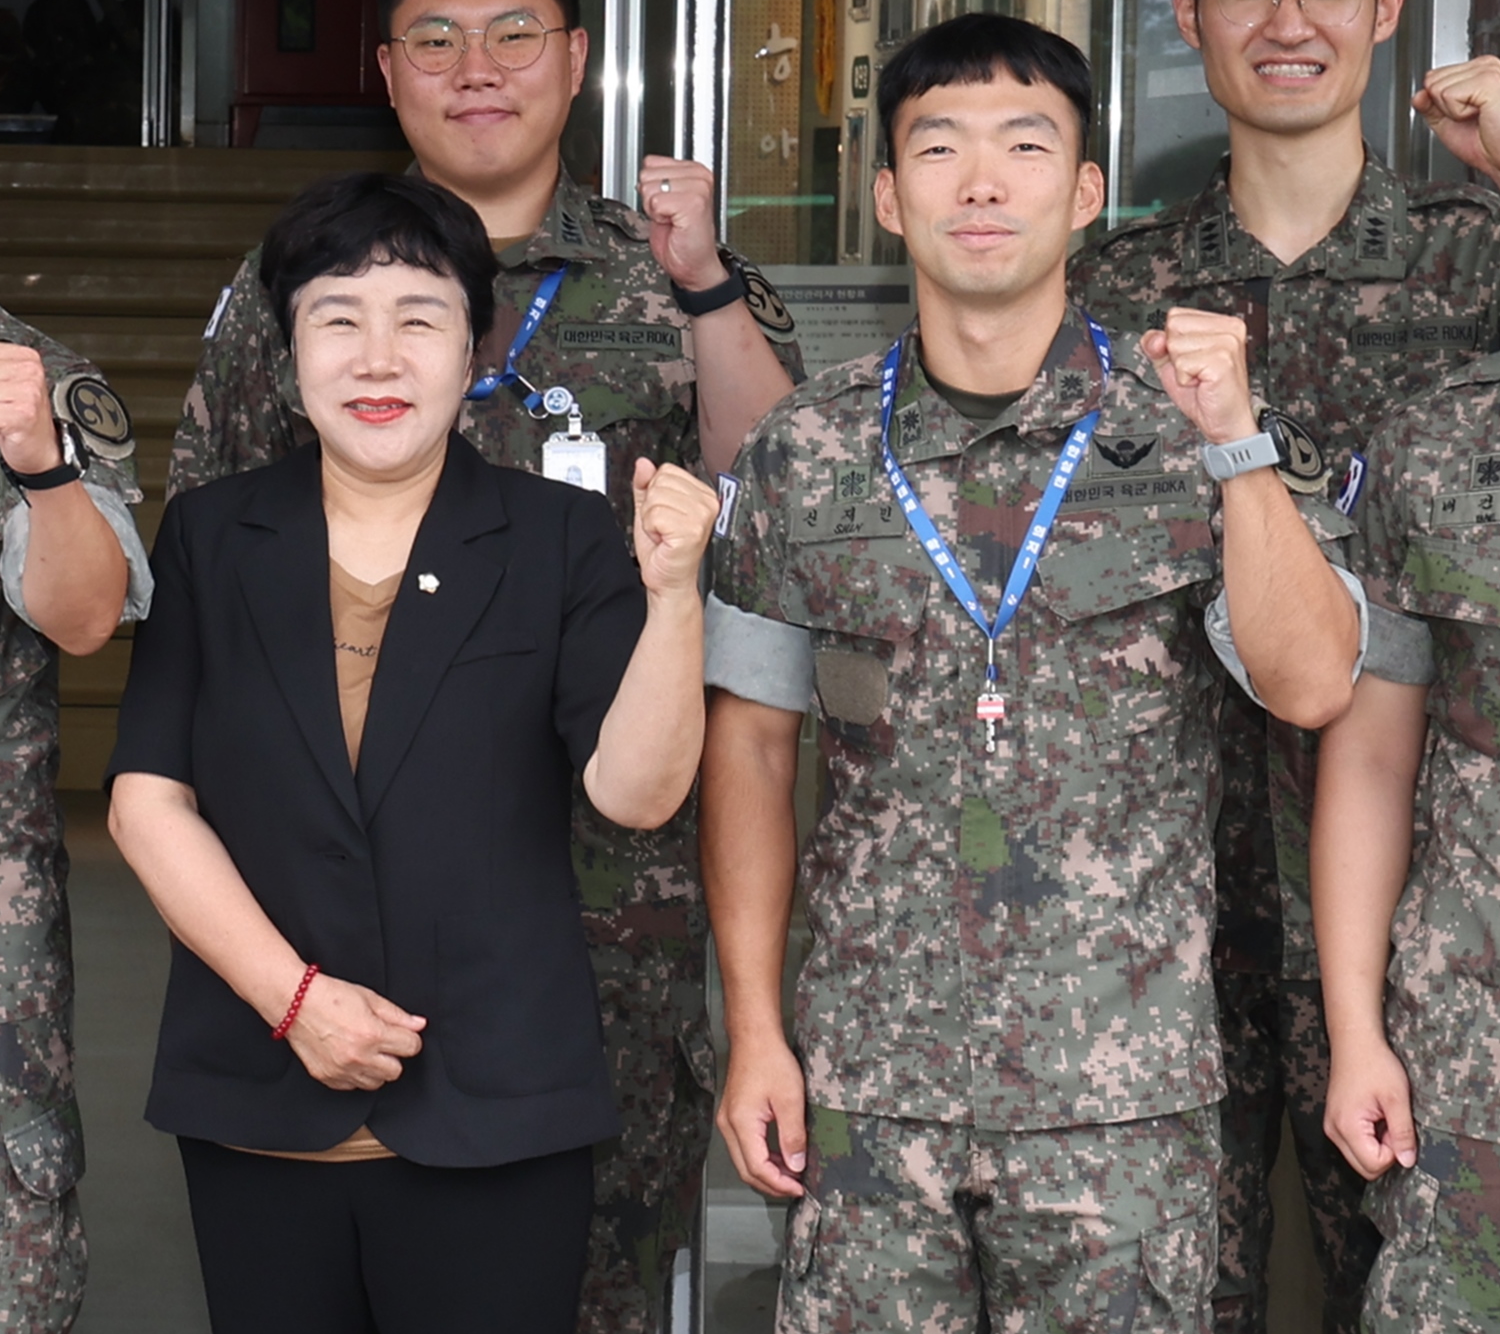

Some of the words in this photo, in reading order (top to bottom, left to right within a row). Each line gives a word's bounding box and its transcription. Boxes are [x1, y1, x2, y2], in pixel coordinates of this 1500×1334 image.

[563, 329, 616, 344] 대한민국
[618, 330, 644, 344] 육군
[646, 330, 676, 347] ROKA
[1357, 329, 1408, 346] 대한민국
[1413, 326, 1438, 341] 육군
[1442, 325, 1473, 341] ROKA
[1121, 482, 1148, 498] 육군
[1153, 479, 1187, 495] ROKA
